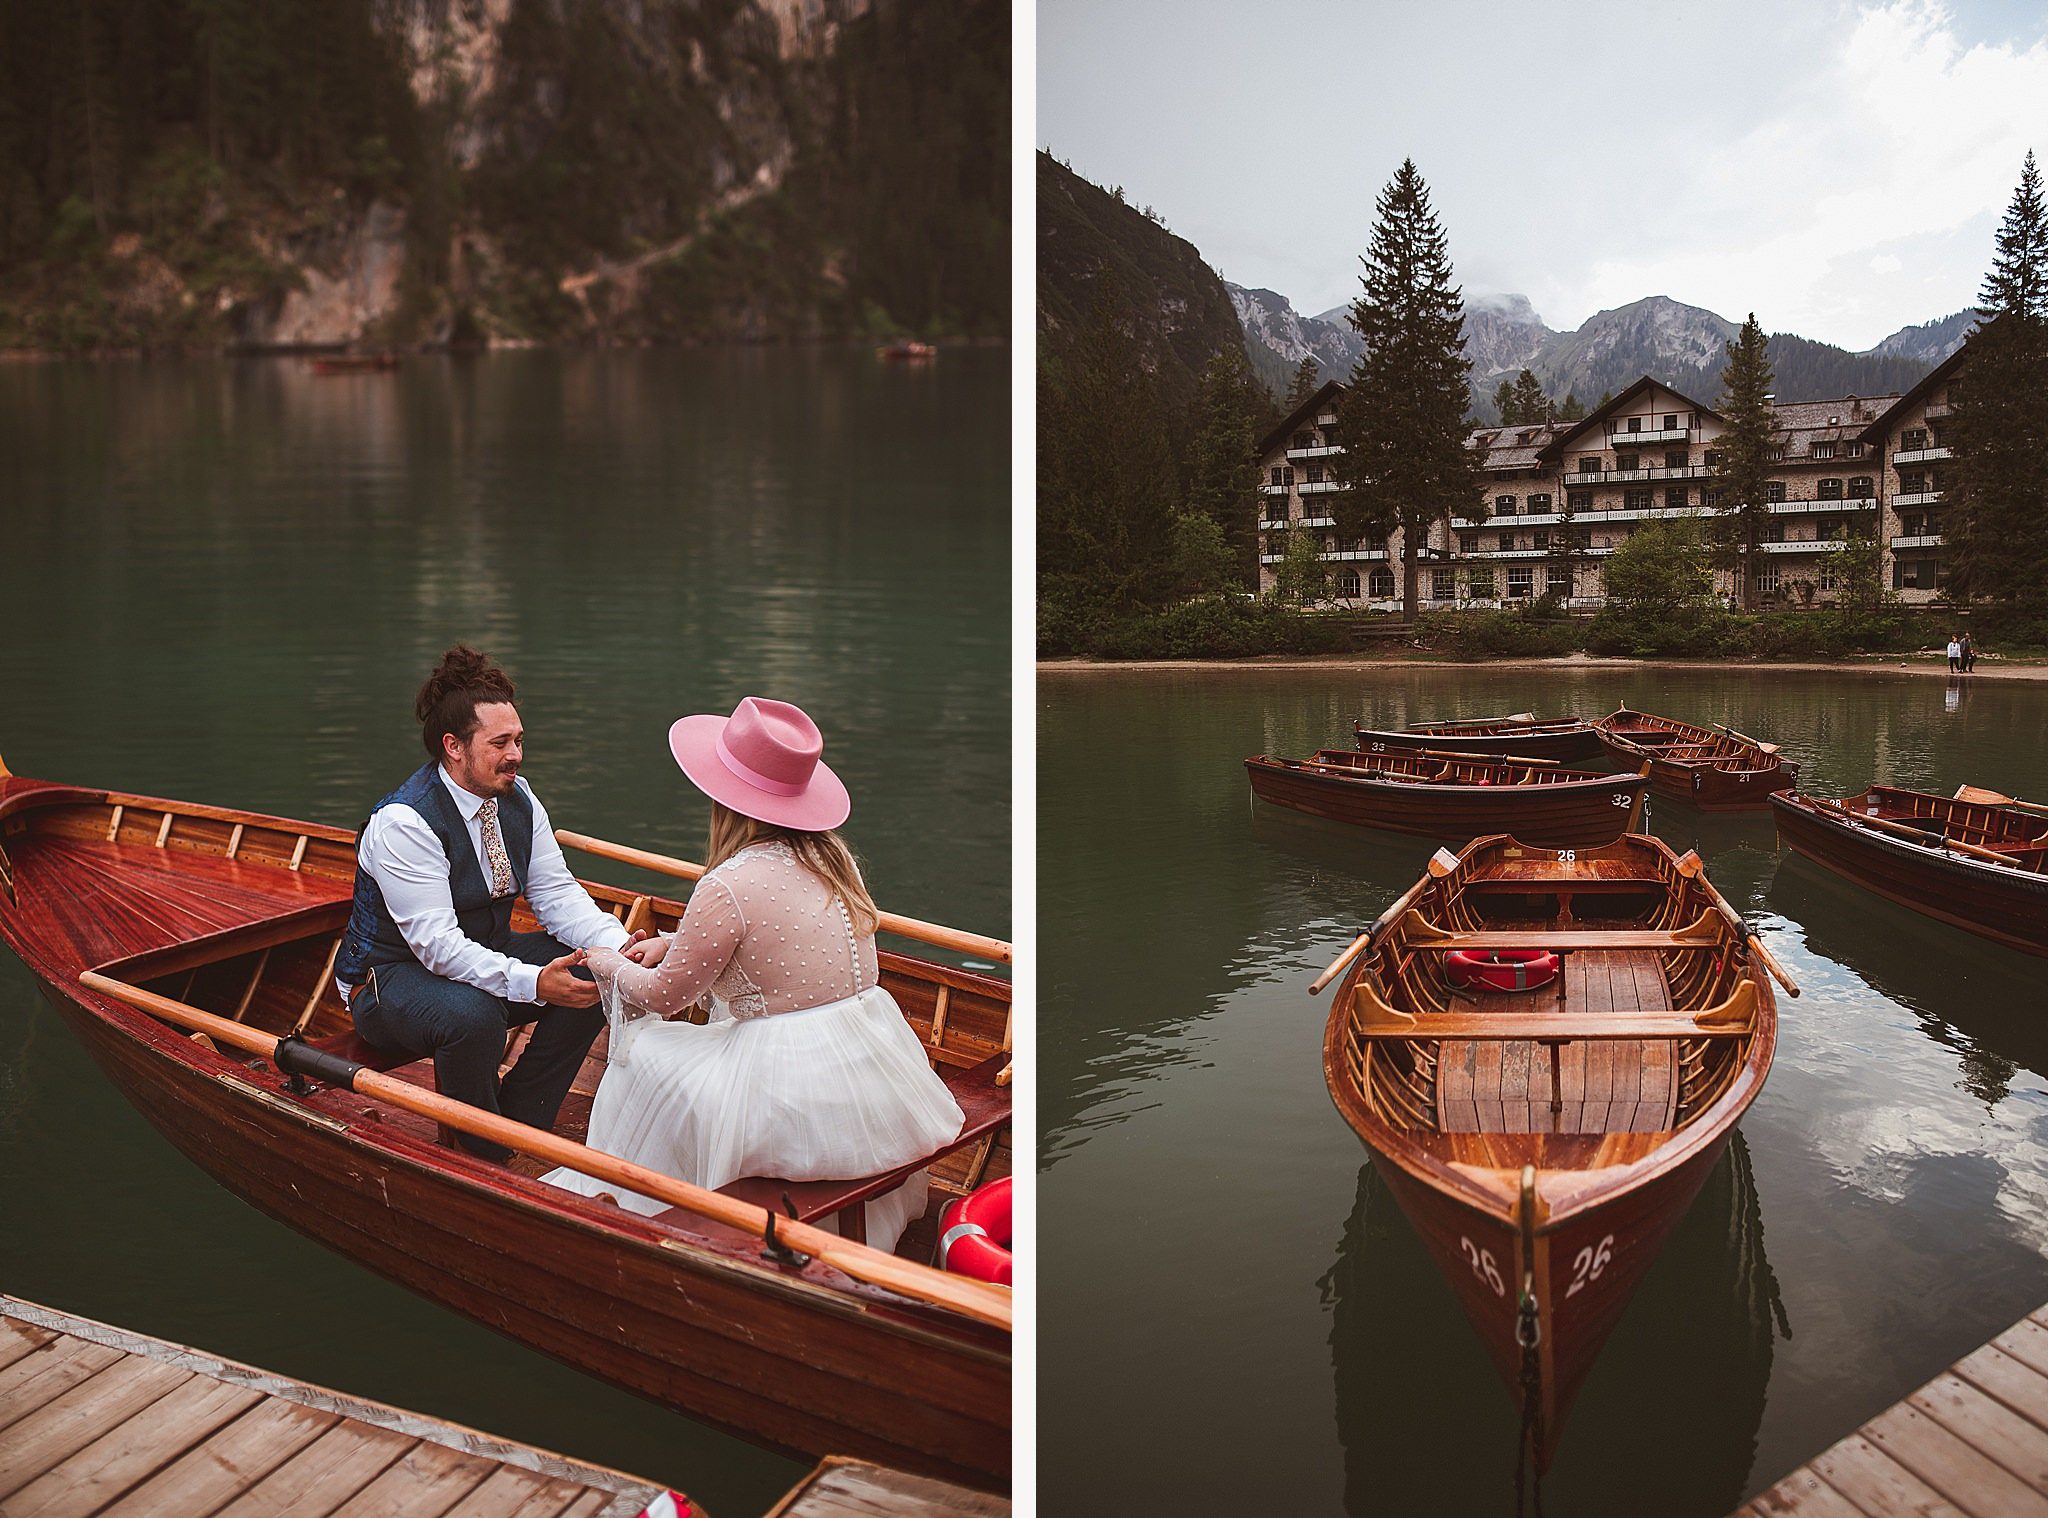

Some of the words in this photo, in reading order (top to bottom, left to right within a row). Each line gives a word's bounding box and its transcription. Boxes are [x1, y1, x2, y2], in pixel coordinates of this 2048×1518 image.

[1739, 773, 1750, 783] 21
[1611, 793, 1632, 809] 32
[1557, 849, 1576, 862] 26
[1460, 1235, 1505, 1297] 26
[1565, 1234, 1614, 1299] 26
